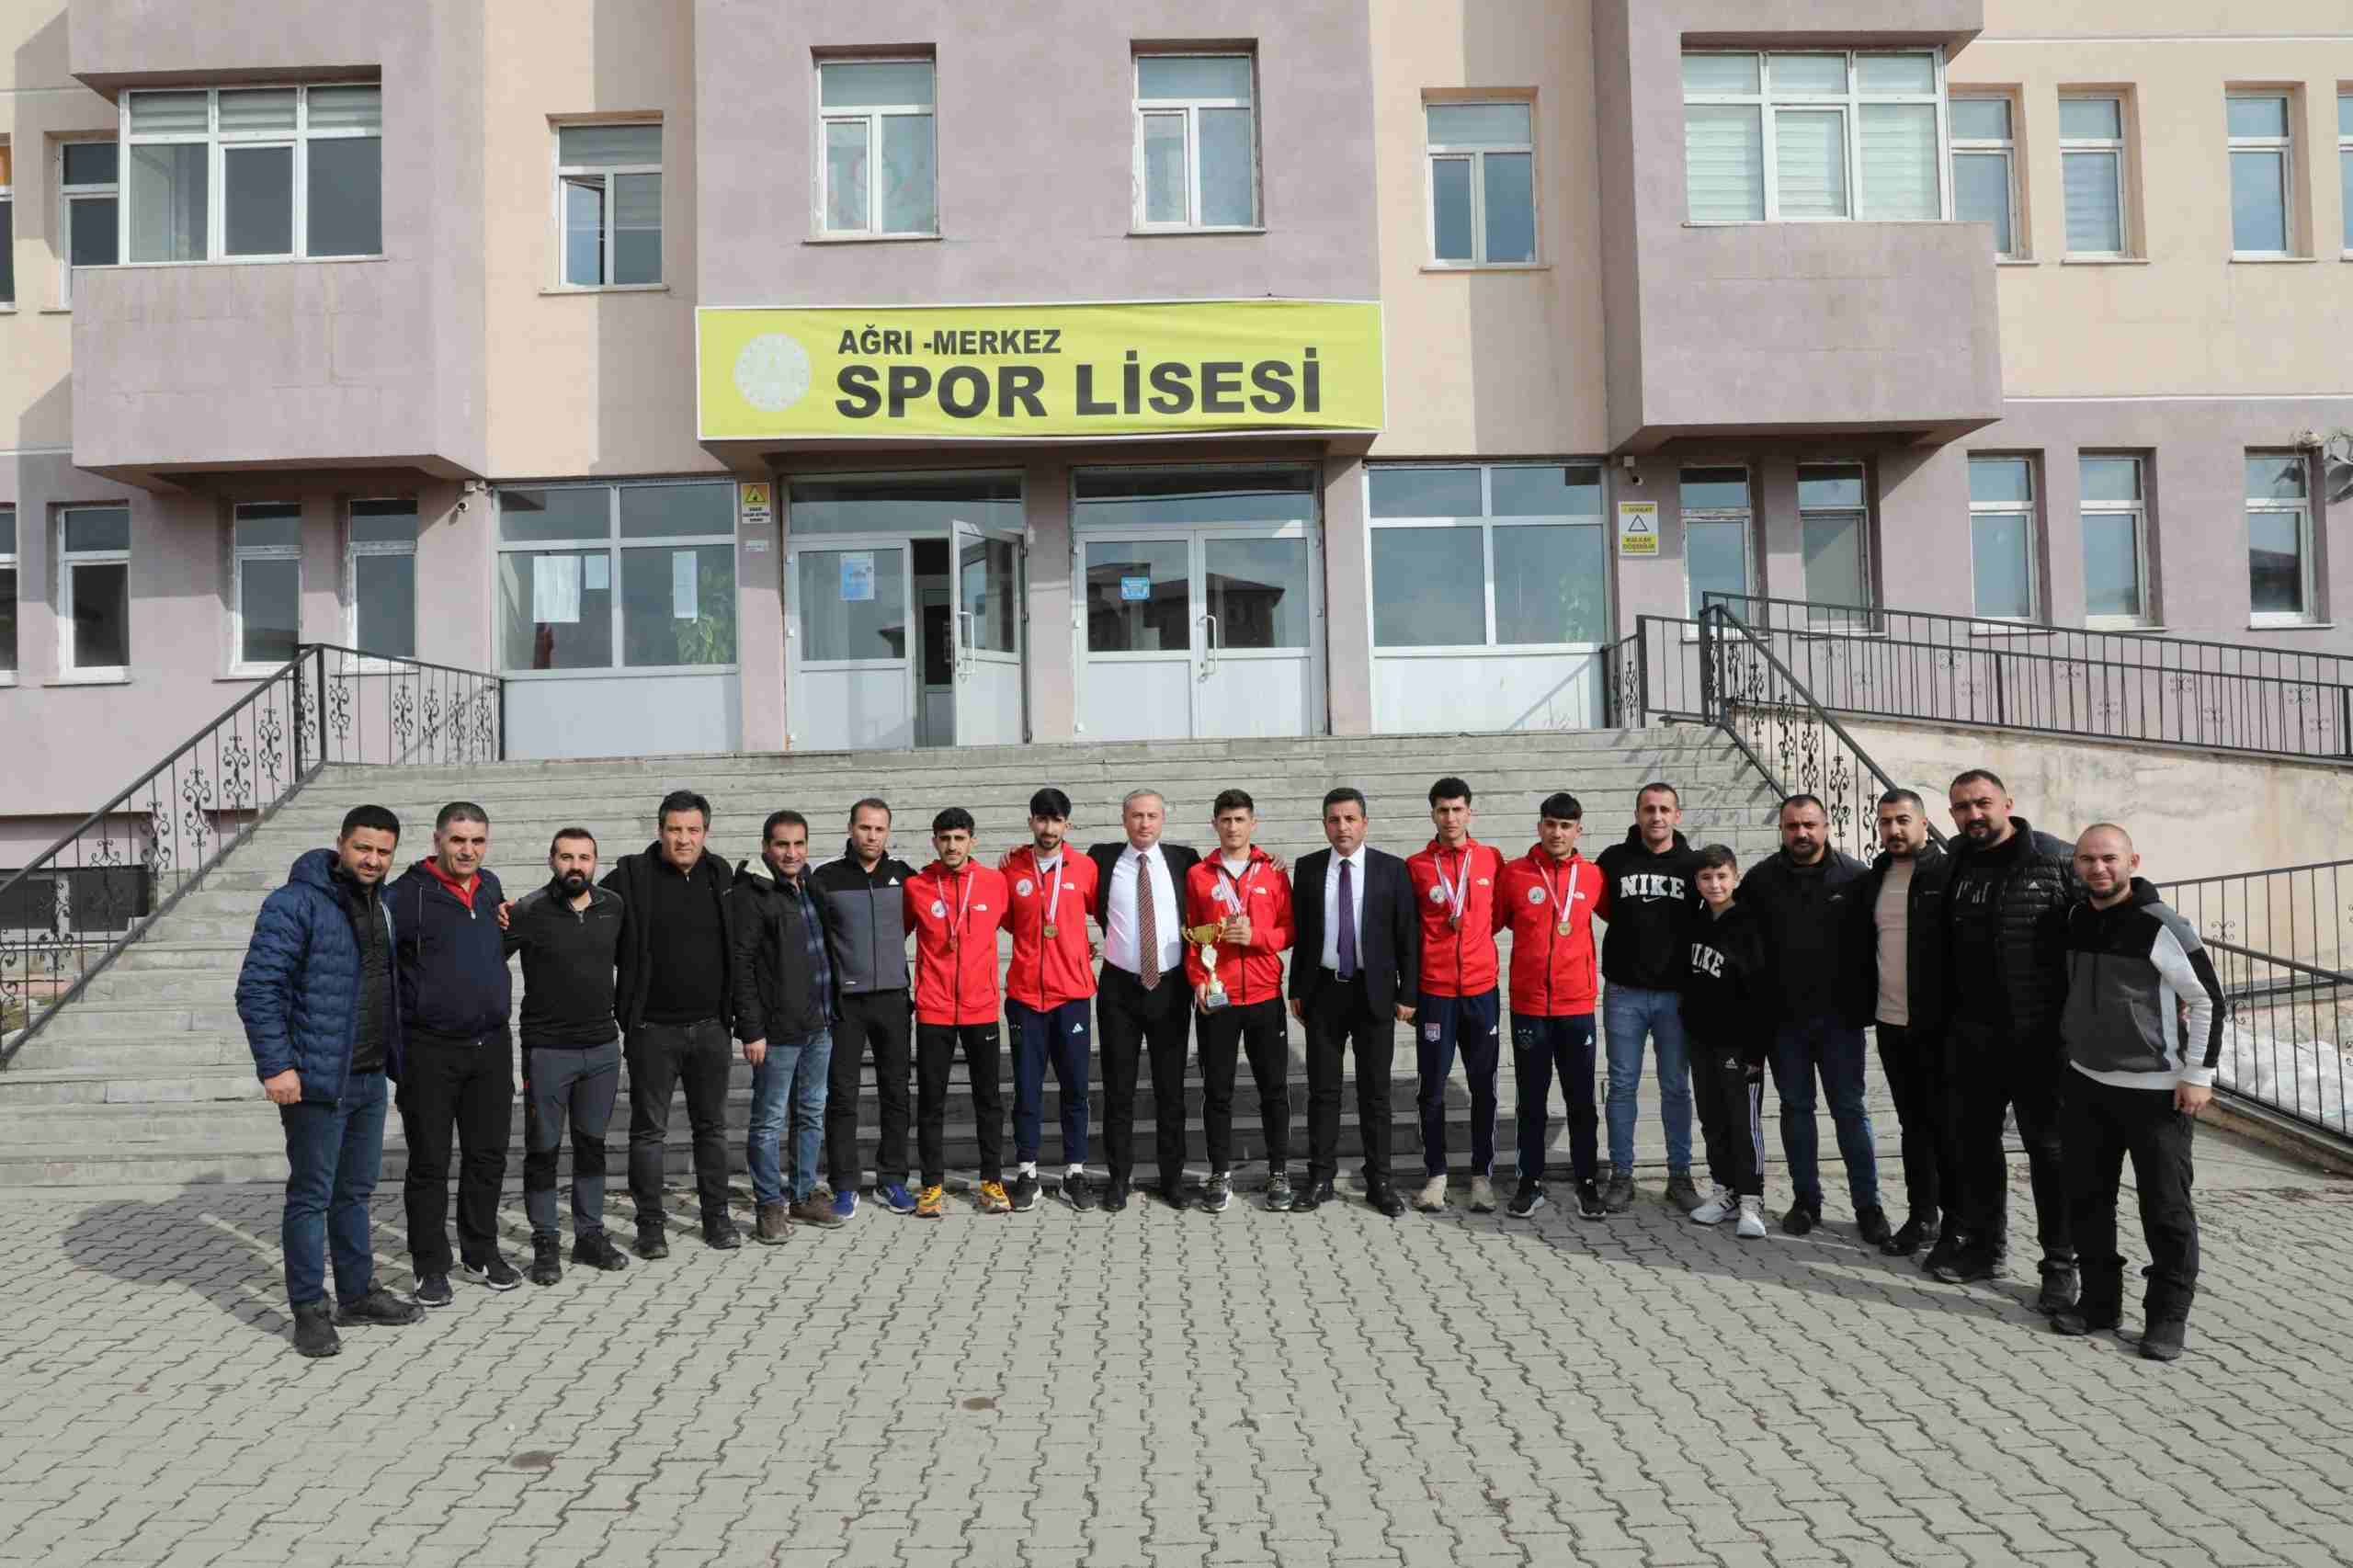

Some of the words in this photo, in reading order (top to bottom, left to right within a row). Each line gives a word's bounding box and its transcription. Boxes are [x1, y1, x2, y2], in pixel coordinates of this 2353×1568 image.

[837, 324, 913, 355] AĞRI
[923, 329, 1062, 355] -MERKEZ
[835, 364, 1048, 419] SPOR
[1075, 347, 1321, 415] LİSESİ
[1620, 874, 1685, 900] NIKE
[1692, 942, 1724, 978] IKE
